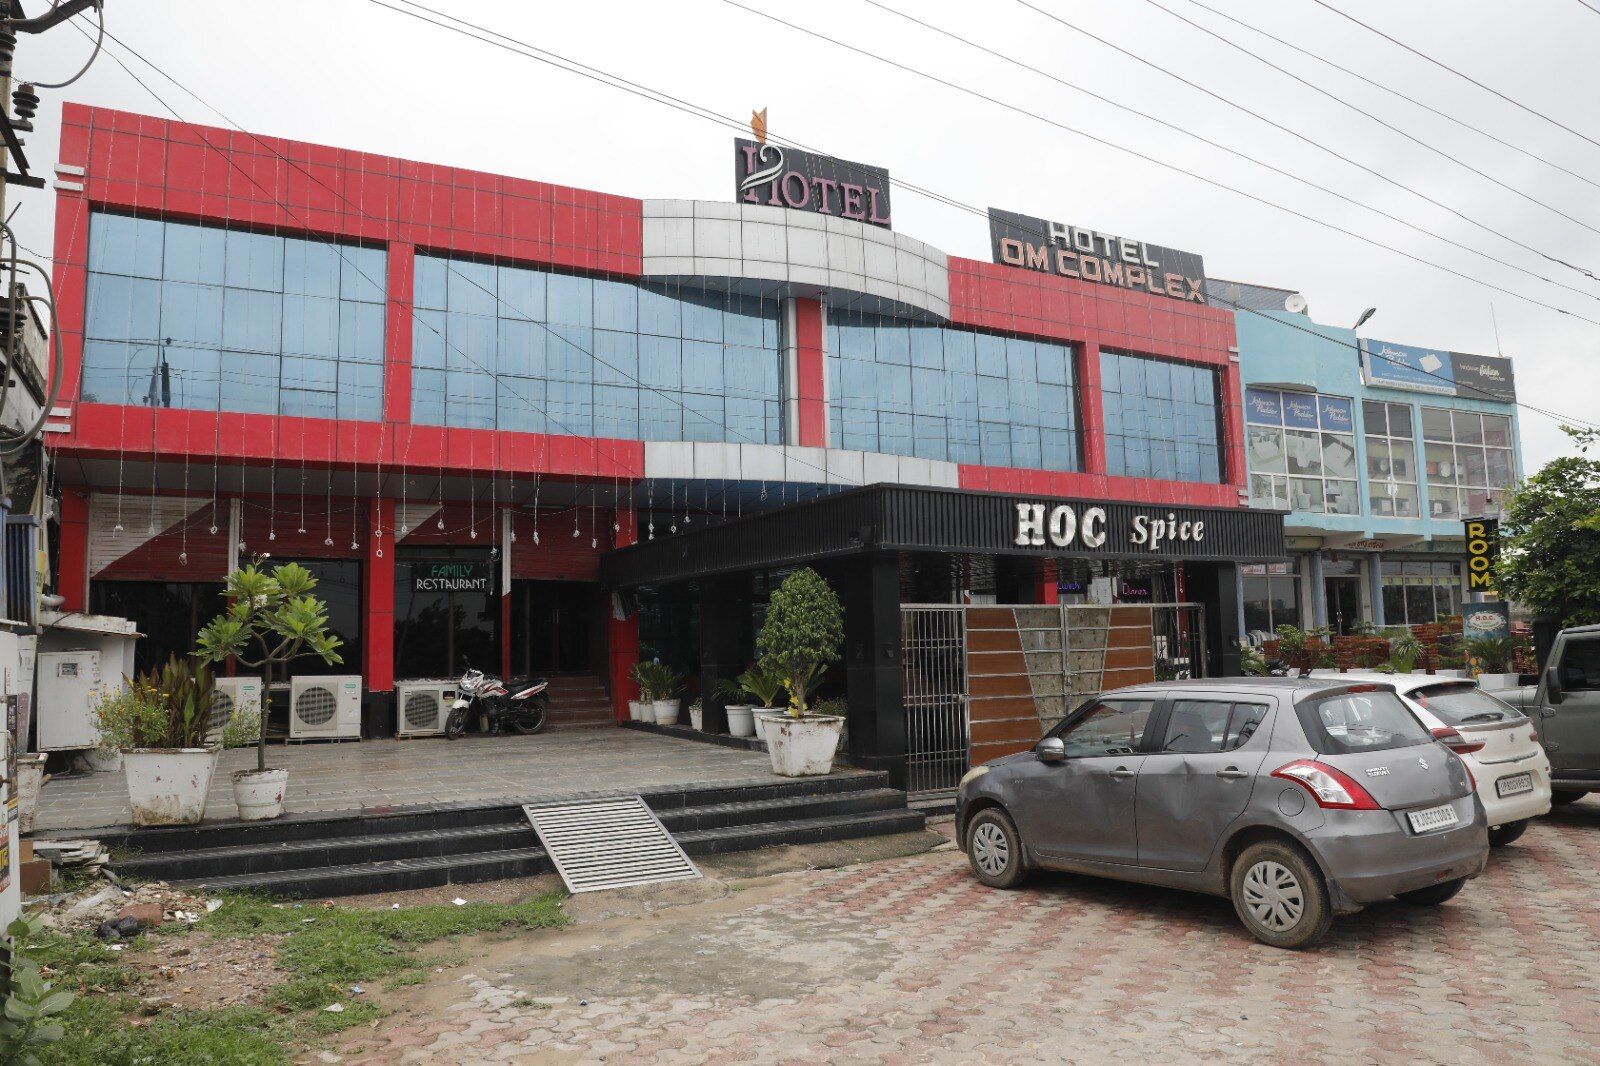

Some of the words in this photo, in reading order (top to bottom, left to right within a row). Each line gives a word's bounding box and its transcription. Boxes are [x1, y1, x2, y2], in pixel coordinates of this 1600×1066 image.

[740, 145, 891, 225] HOTEL
[1048, 221, 1159, 268] HOTEL
[1001, 237, 1048, 271] OM
[1057, 250, 1204, 303] COMPLEX
[1015, 503, 1106, 548] HOC
[1129, 512, 1204, 550] Spice
[431, 564, 473, 577] FAMILY
[1468, 523, 1491, 588] ROOM
[416, 578, 487, 590] RESTAURANT
[1122, 582, 1148, 595] Dinner
